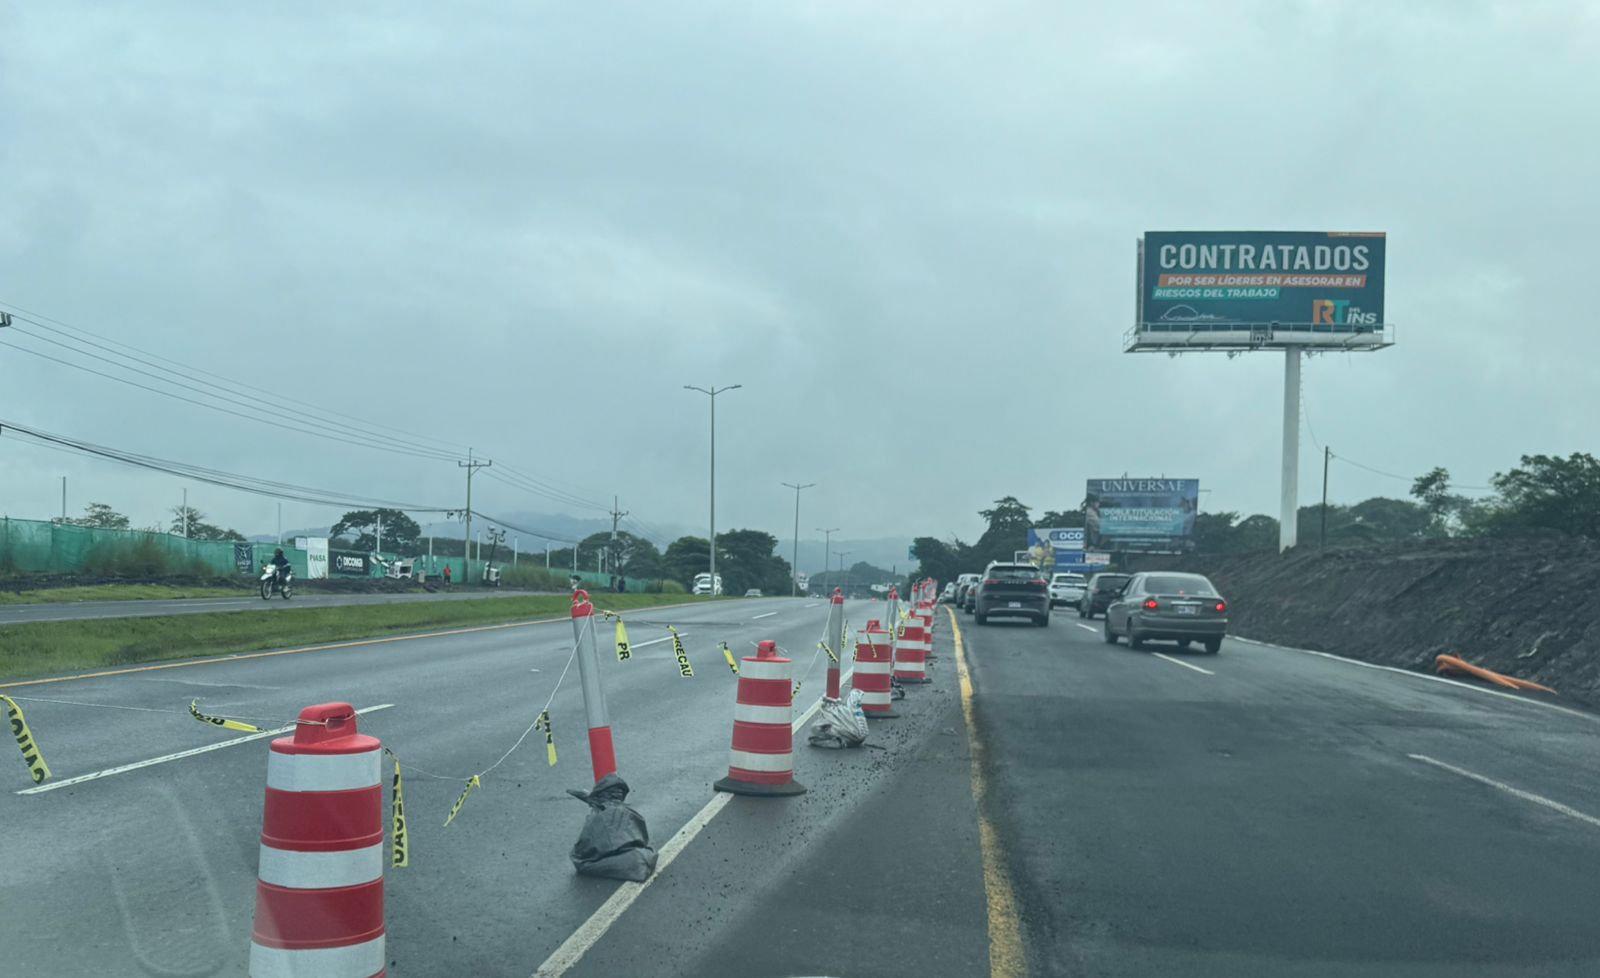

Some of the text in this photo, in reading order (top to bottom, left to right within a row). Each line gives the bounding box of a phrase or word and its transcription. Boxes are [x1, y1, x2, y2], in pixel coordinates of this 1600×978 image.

[1160, 244, 1369, 270] CONTRATADOS
[1167, 273, 1361, 287] POR SER LÍDERES EN ASESORAR EN
[1203, 288, 1225, 298] DEL
[1227, 288, 1277, 297] TRABAJO
[1313, 299, 1350, 325] RT
[1101, 480, 1185, 492] UNIVERSAE
[618, 642, 630, 660] PR
